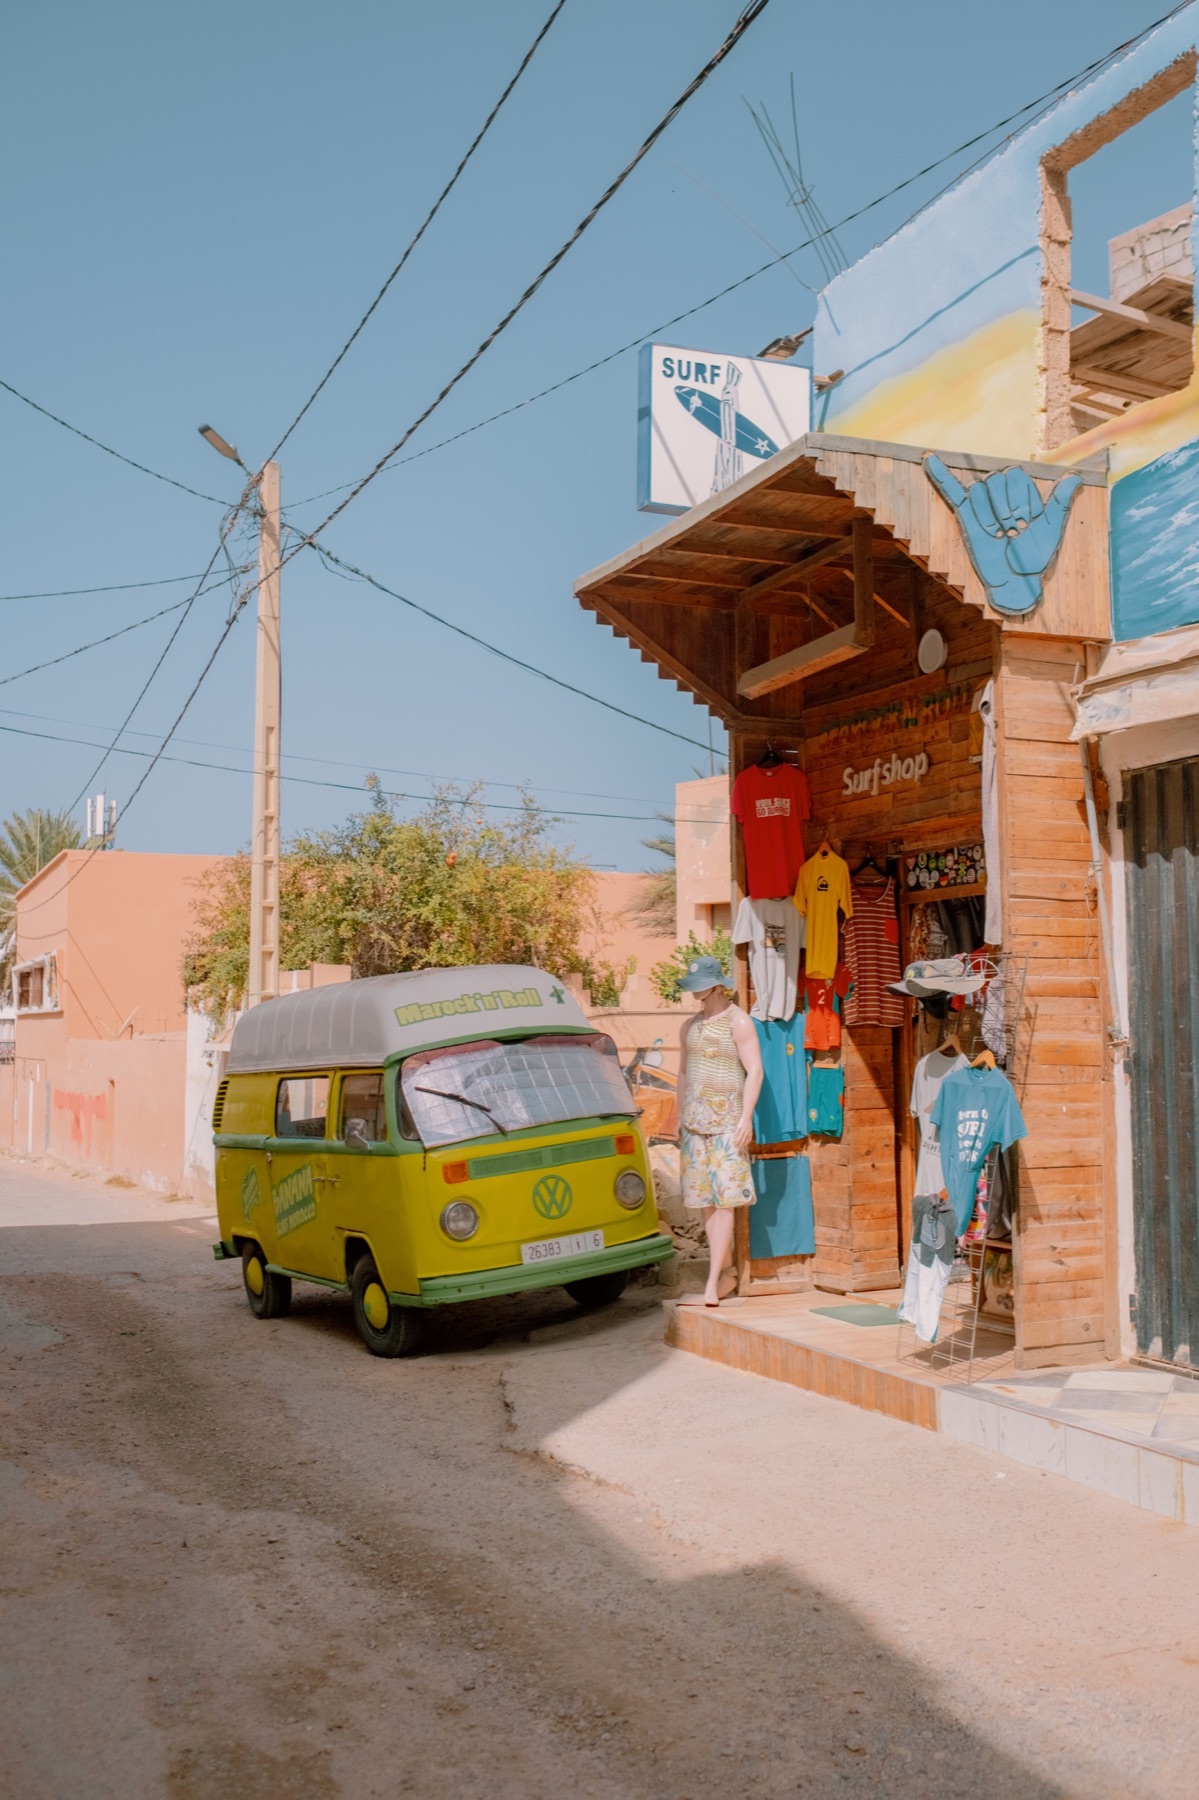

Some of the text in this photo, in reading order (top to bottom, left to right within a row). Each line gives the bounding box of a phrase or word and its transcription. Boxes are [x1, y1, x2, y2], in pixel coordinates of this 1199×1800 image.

[662, 357, 722, 385] SURF
[842, 752, 929, 796] Surfshop
[817, 989, 826, 1005] 2
[592, 1233, 600, 1247] 6
[528, 1241, 562, 1260] 26383
